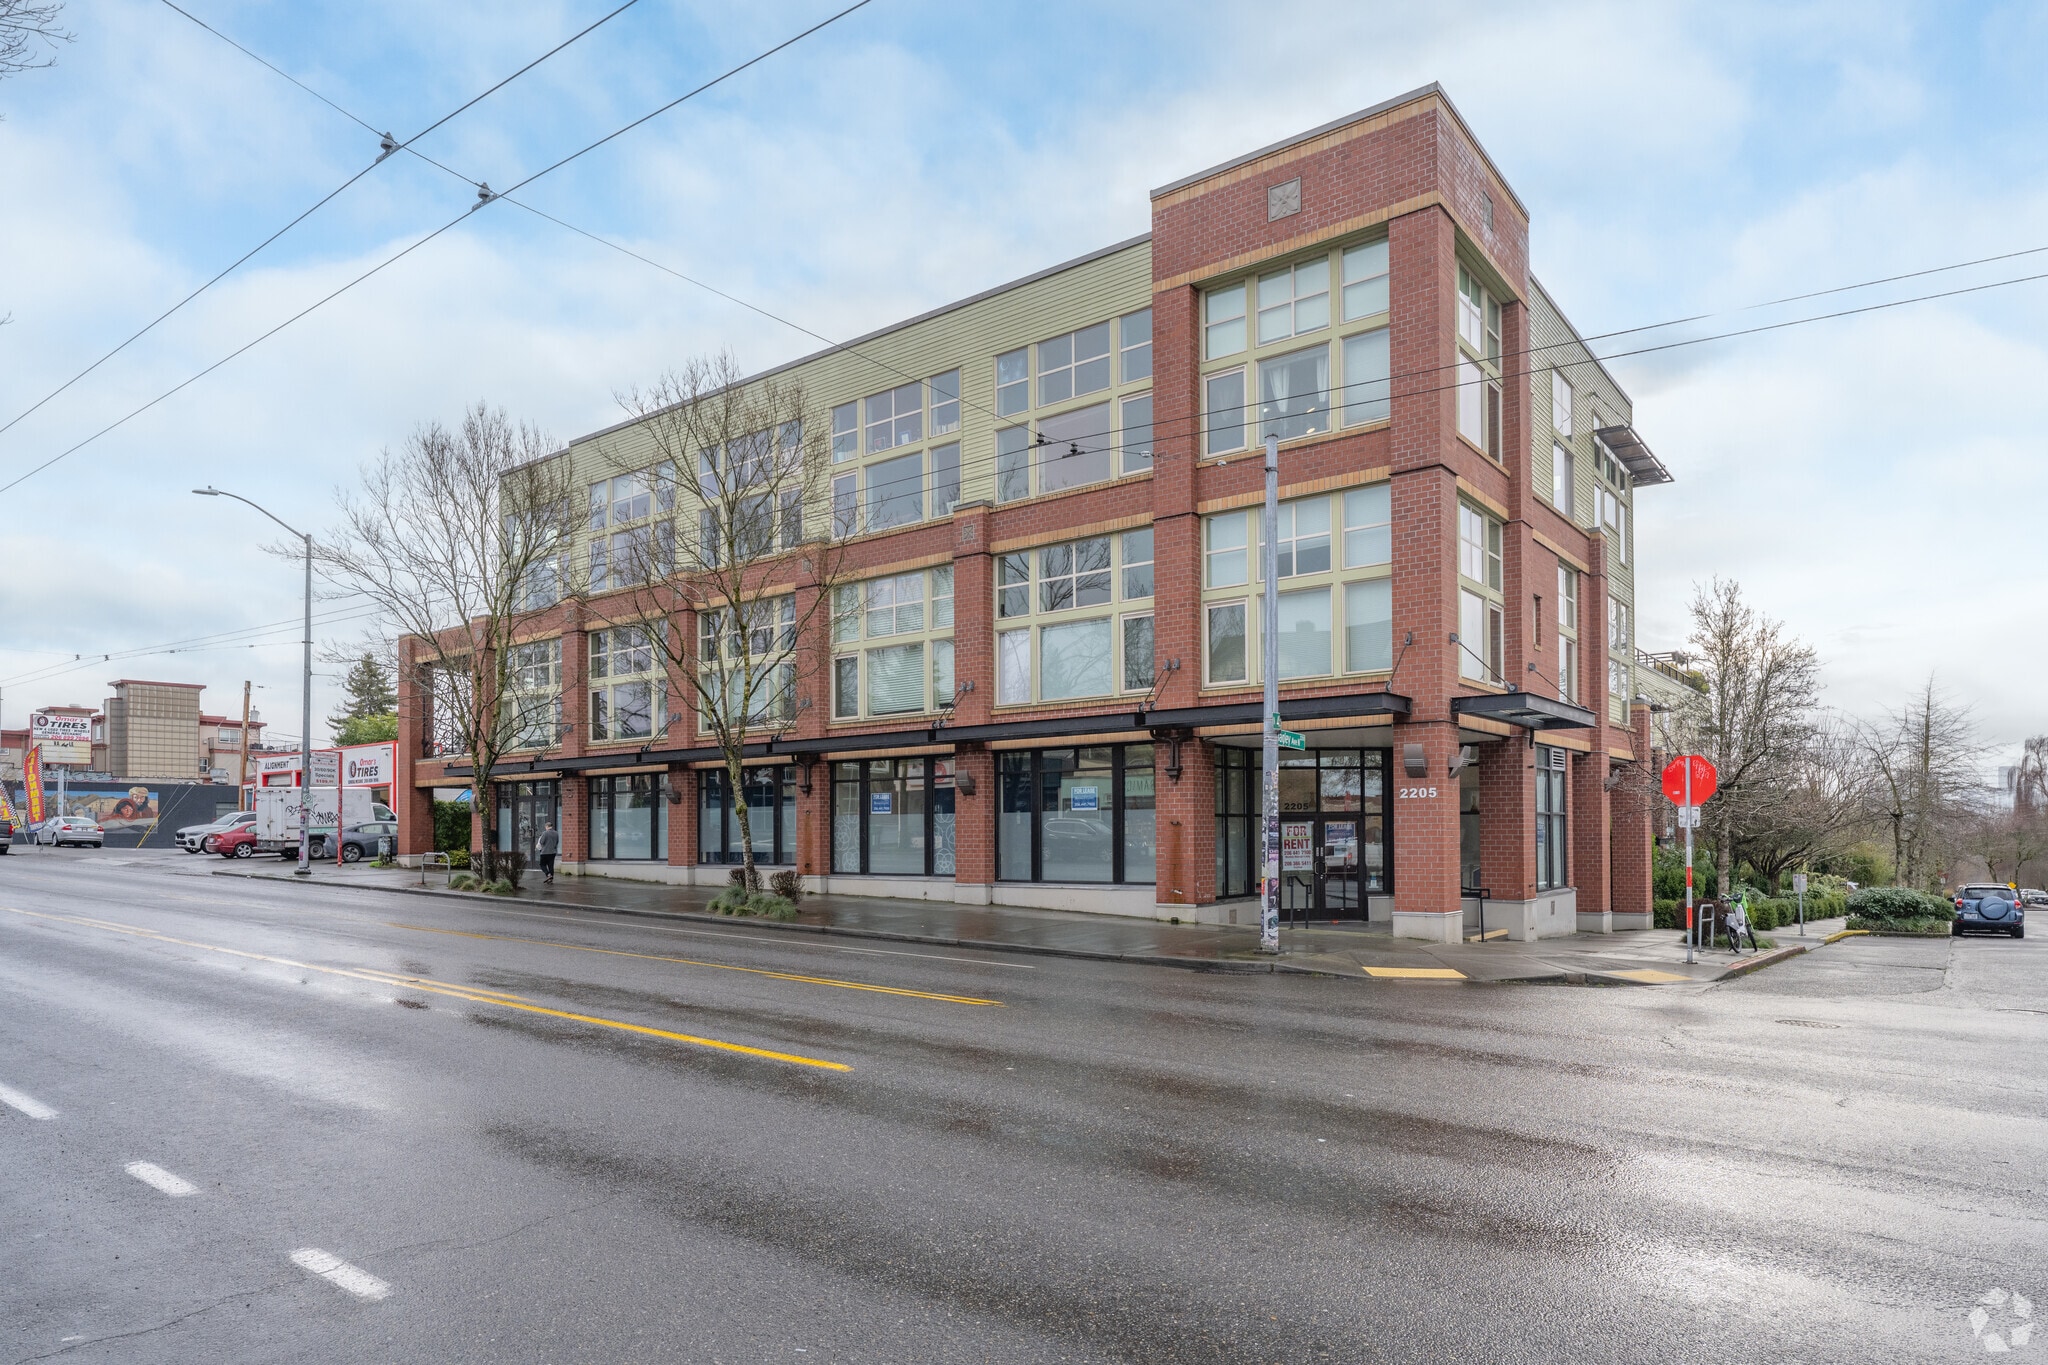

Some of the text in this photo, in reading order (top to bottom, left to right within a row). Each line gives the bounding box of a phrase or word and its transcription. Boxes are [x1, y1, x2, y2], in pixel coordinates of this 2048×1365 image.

[50, 721, 87, 729] TIRES
[264, 760, 289, 770] ALIGNMENT
[359, 758, 376, 766] Omar's
[357, 766, 379, 777] TIRES
[1400, 787, 1437, 798] 2205
[1286, 825, 1307, 837] FOR
[1283, 838, 1310, 850] RENT
